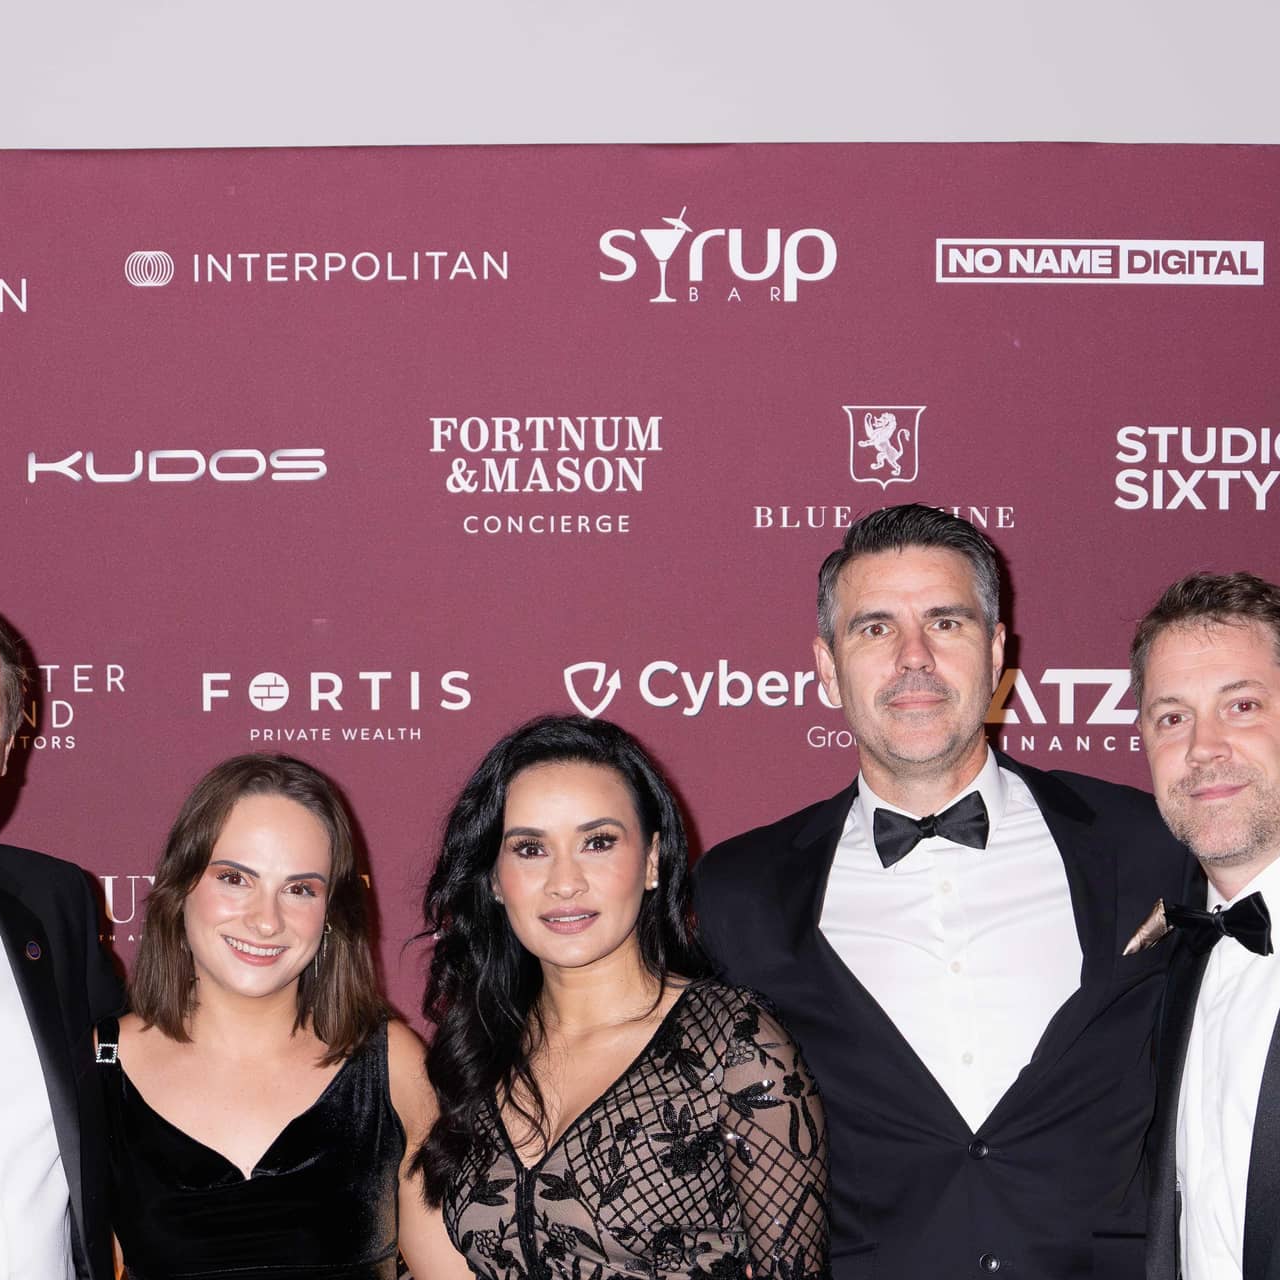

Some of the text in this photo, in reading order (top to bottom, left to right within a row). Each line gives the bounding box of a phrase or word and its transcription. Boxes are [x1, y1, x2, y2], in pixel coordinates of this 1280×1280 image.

[193, 250, 508, 283] INTERPOLITAN
[947, 247, 1260, 276] NO NAME DIGITAL
[688, 286, 781, 303] BAR
[429, 416, 663, 453] FORTNUM
[27, 448, 328, 484] KUDOS
[445, 456, 647, 494] &MASON
[463, 514, 630, 534] CONCIERGE
[754, 506, 852, 529] BLUE
[22, 664, 125, 692] TER
[202, 670, 472, 712] FORTIS
[984, 668, 1138, 724] ATZ
[23, 700, 74, 728] ND
[250, 727, 421, 741] PRIVATE WEALTH
[807, 726, 857, 748] Gro
[1003, 735, 1140, 751] INANCE
